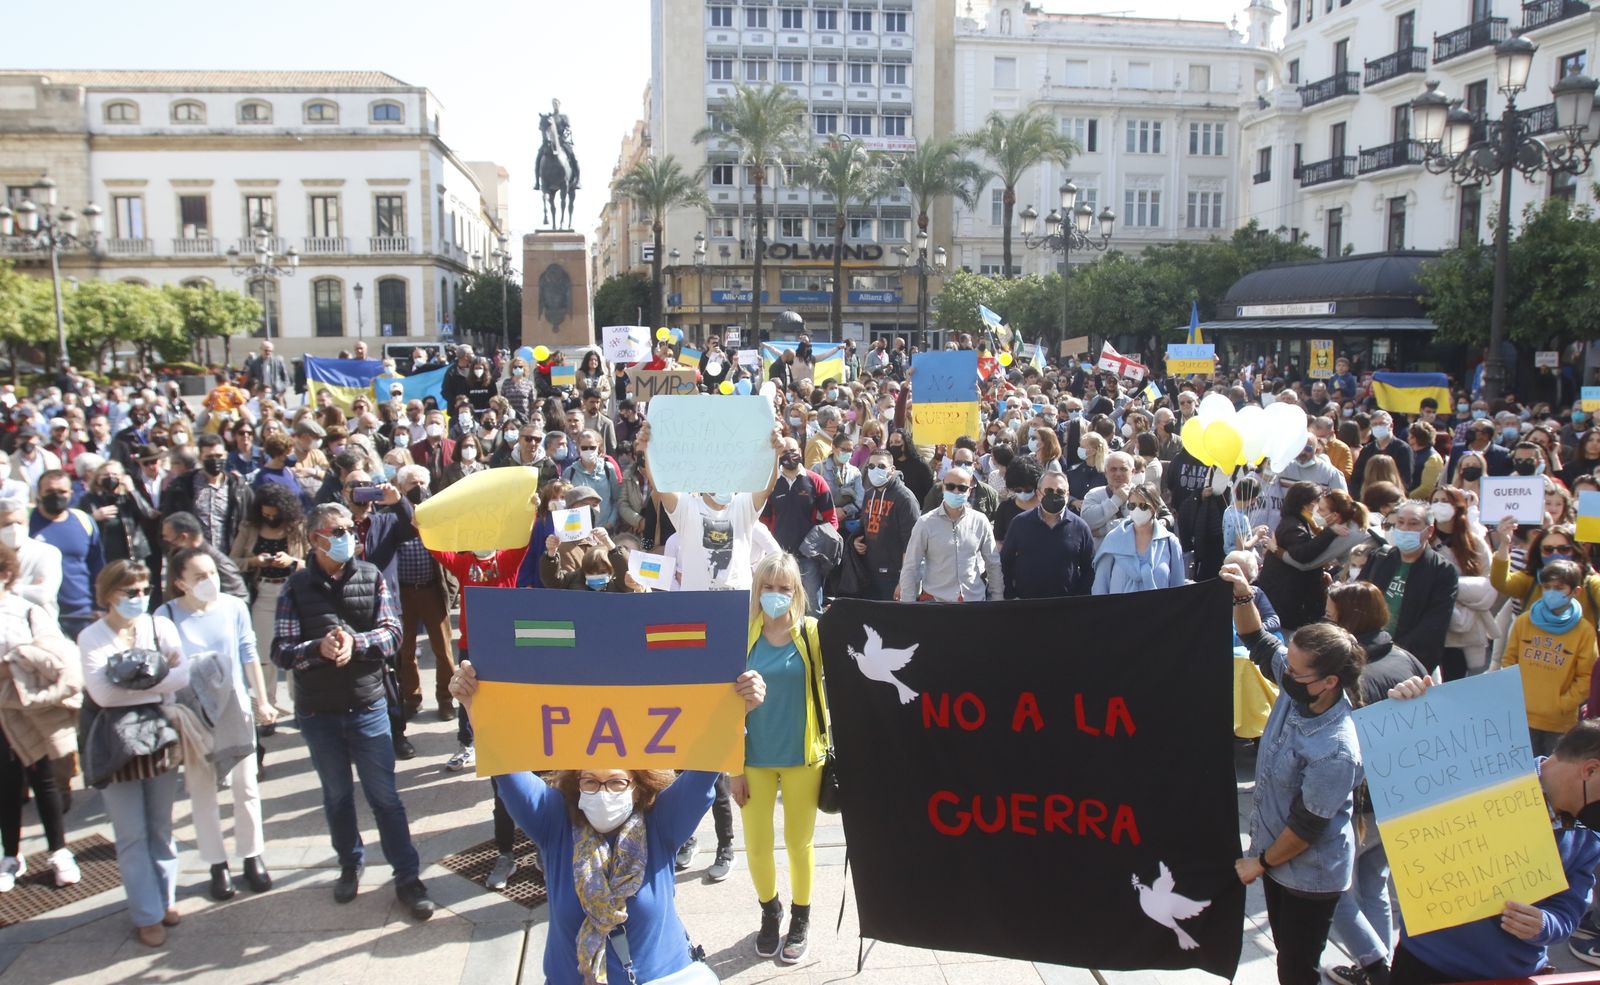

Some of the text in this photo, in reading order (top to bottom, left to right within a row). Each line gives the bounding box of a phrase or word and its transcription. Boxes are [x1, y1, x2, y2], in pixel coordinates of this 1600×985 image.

[859, 293, 882, 301] Allianz
[635, 375, 682, 397] МИР
[1180, 475, 1204, 488] OUT
[1181, 464, 1206, 477] FAR
[1493, 487, 1532, 497] GUERRA
[1504, 502, 1520, 511] NO
[1524, 648, 1566, 666] CREW
[1532, 636, 1563, 652] USA
[541, 703, 682, 757] PAZ
[921, 691, 1136, 737] NO A LA
[1383, 745, 1529, 809] IS OUR HEART
[927, 789, 1141, 846] GUERRA
[1393, 788, 1542, 851] SPANISH PEOPLE
[1404, 835, 1489, 878] IS WITH
[1406, 846, 1530, 900] UKRAINIAN
[1426, 864, 1553, 919] POPULATION
